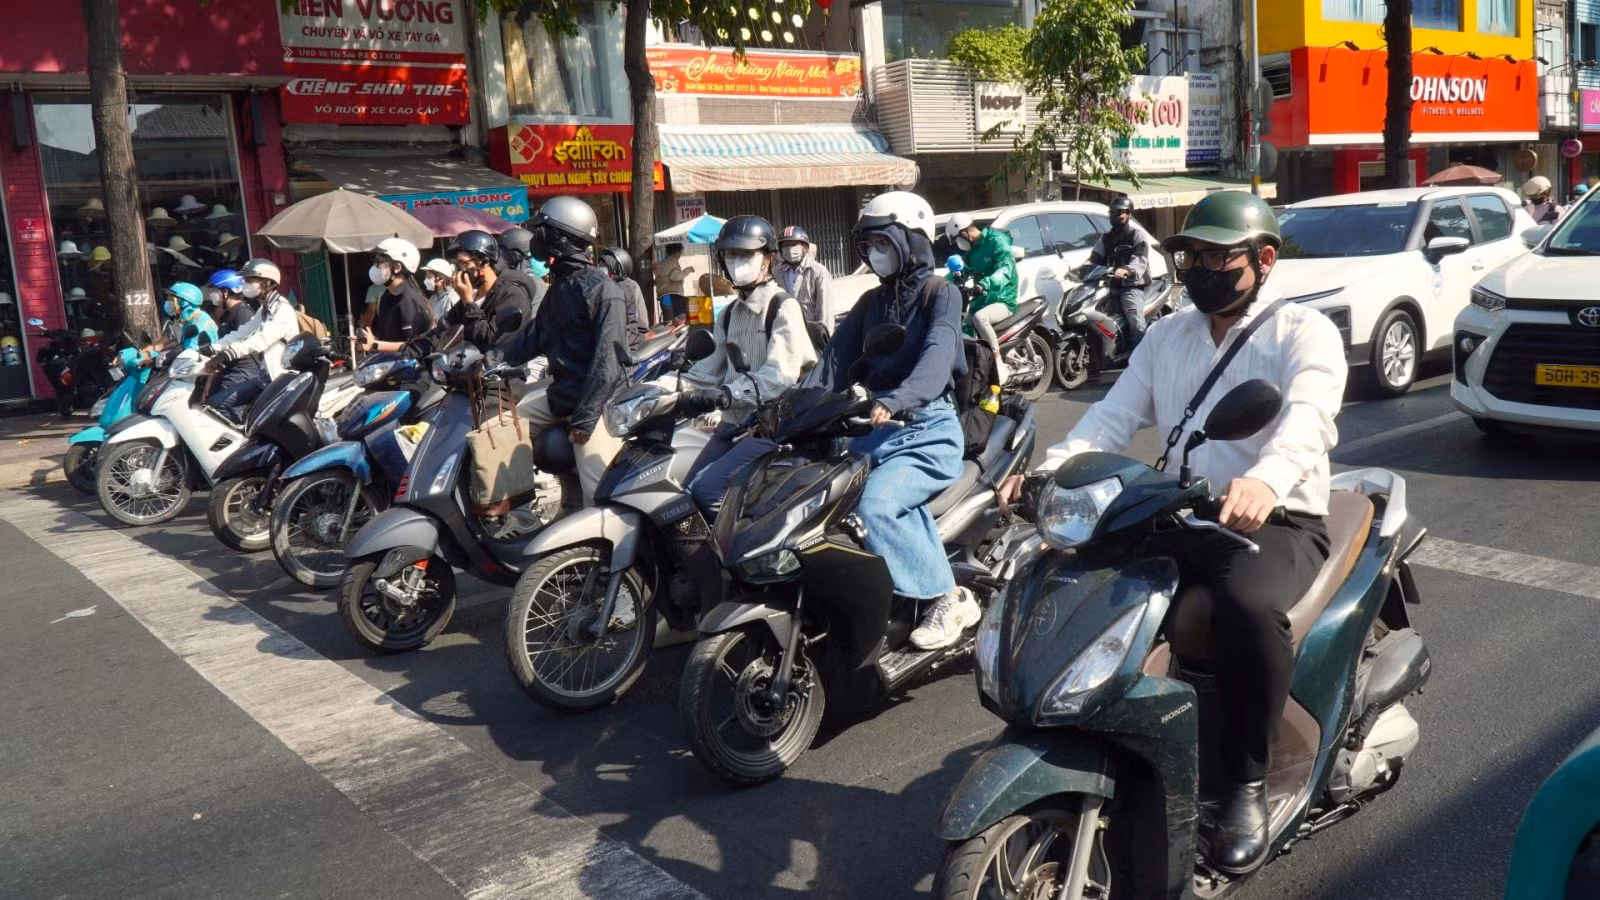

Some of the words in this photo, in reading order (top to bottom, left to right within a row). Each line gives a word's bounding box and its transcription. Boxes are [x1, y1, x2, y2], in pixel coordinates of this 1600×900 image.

[388, 31, 401, 41] XE
[405, 32, 423, 42] TAY
[425, 33, 441, 43] GA
[287, 78, 357, 96] CHENG
[355, 82, 406, 96] SHIN
[412, 84, 463, 96] TIRE
[1410, 76, 1487, 102] OHNSON
[371, 106, 385, 115] XE
[389, 106, 413, 115] CAO
[547, 173, 565, 185] HOA
[126, 293, 150, 305] 122
[663, 502, 691, 520] YAMAHA
[799, 536, 825, 551] HONDA
[1160, 701, 1193, 723] HONDA
